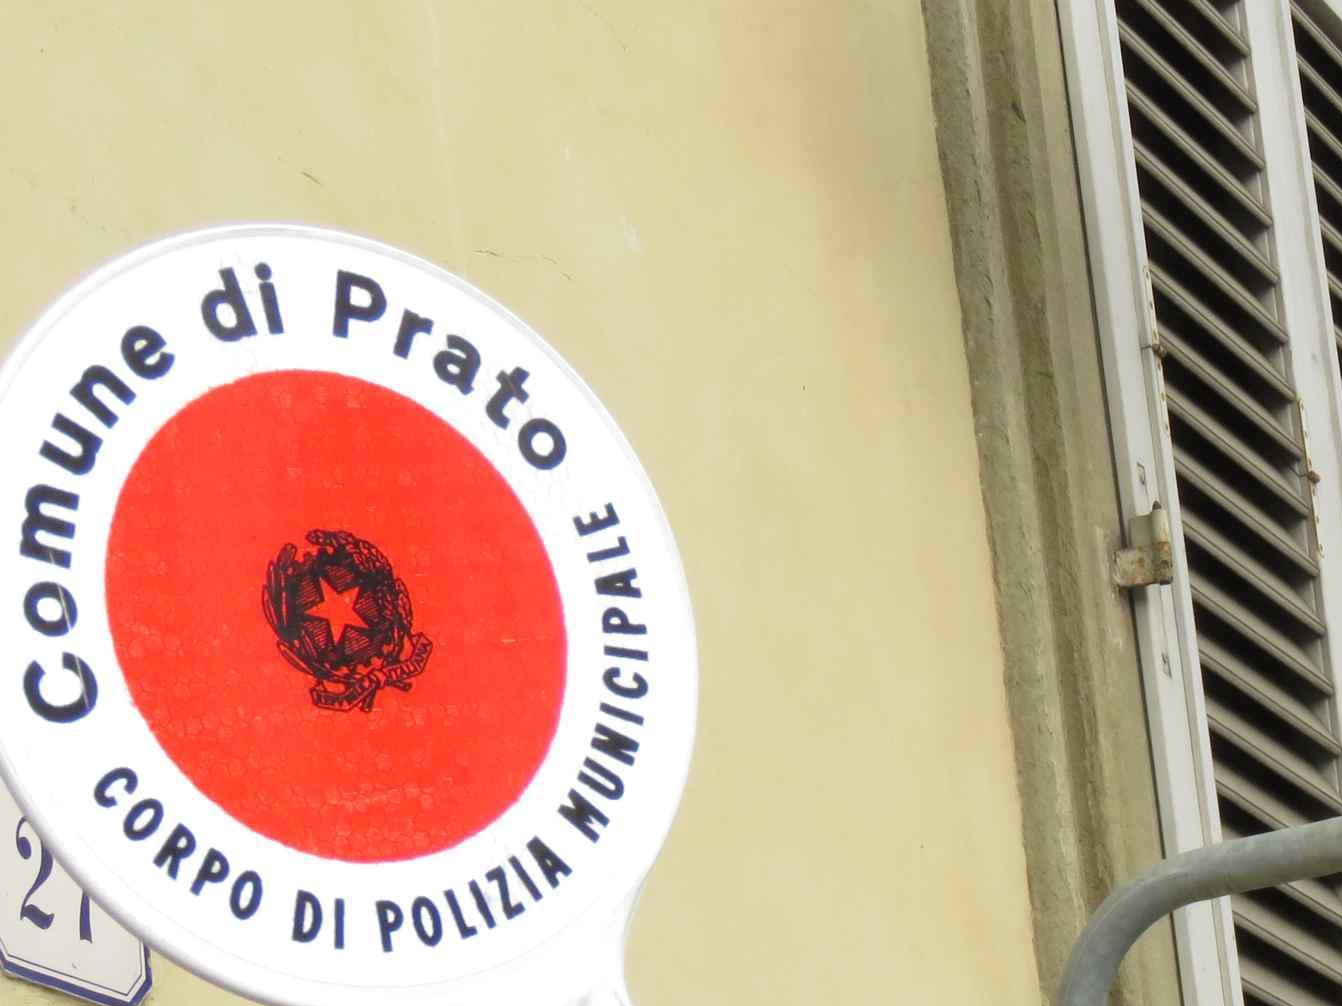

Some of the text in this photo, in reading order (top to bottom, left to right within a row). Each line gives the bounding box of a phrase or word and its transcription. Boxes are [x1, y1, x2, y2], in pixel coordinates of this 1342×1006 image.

[20, 262, 567, 724] Comune di Prato
[93, 503, 649, 953] CORPO DI POLIZIA MUNICIPALE
